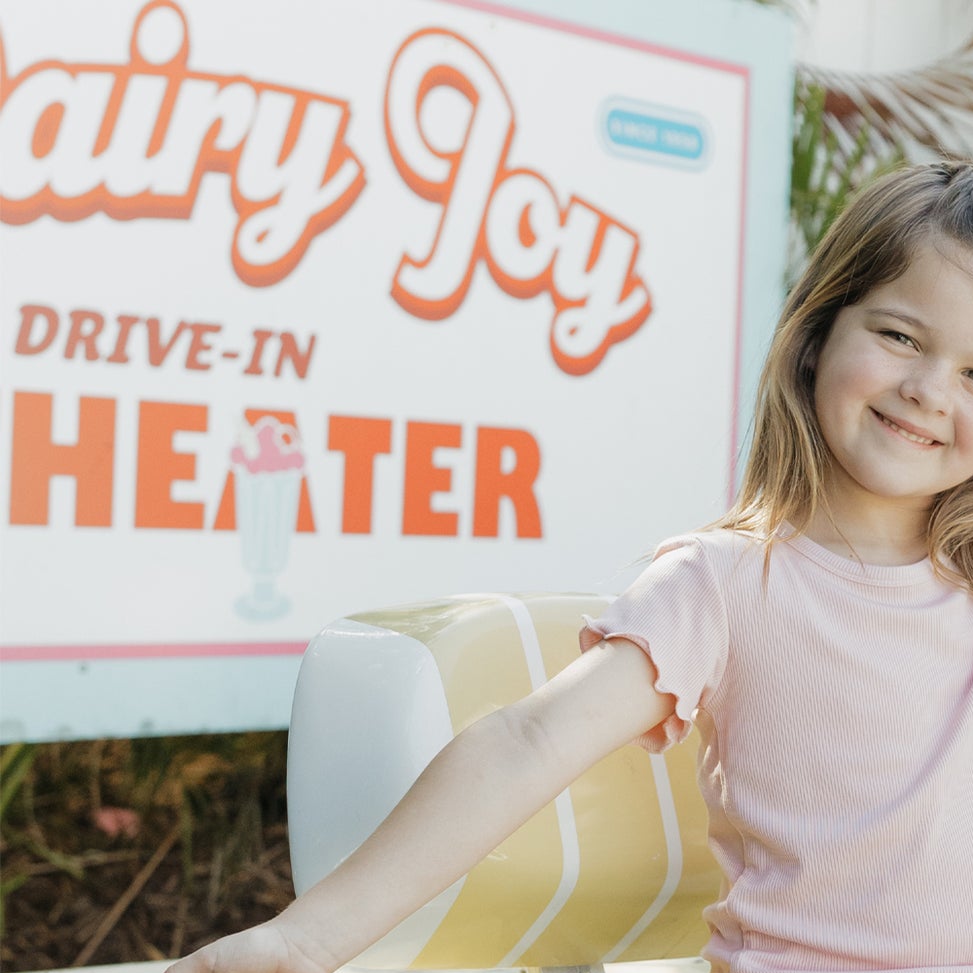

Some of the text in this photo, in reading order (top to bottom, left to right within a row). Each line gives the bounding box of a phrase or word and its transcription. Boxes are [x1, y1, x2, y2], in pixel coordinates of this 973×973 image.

[0, 0, 652, 376] airy Joy
[15, 303, 316, 379] DRIVE-IN
